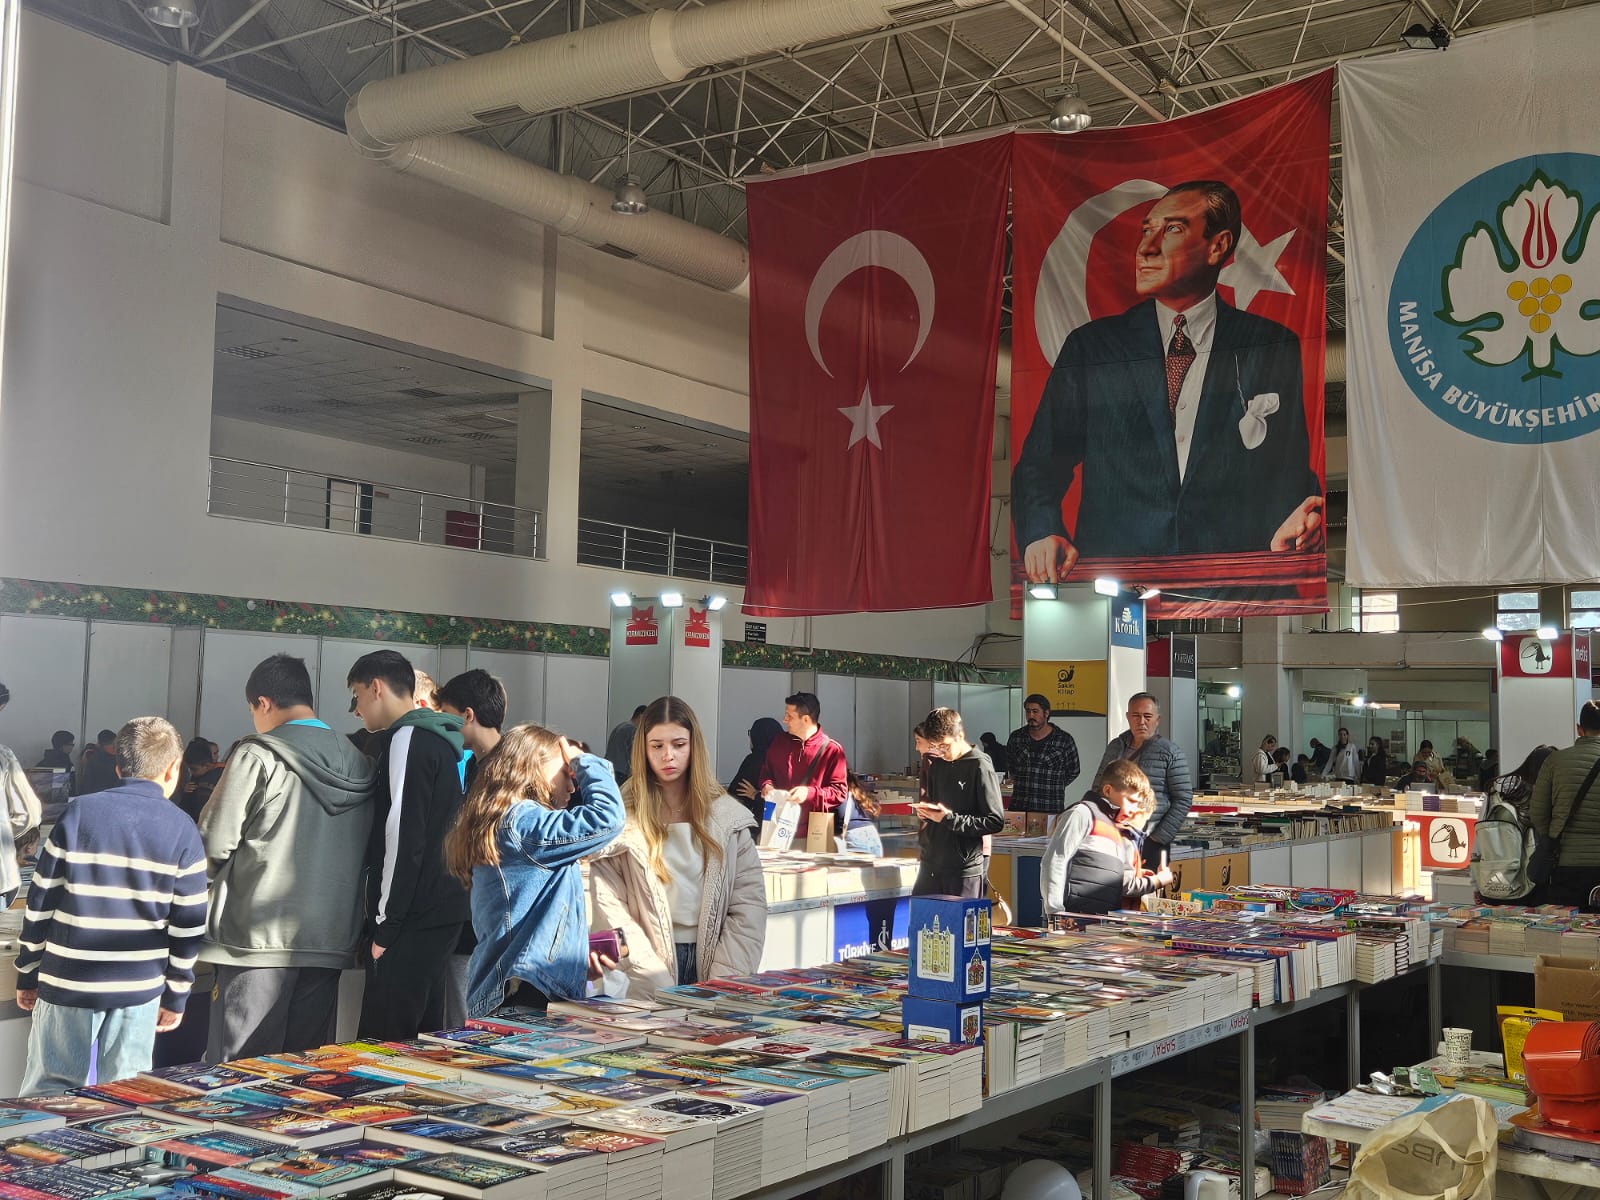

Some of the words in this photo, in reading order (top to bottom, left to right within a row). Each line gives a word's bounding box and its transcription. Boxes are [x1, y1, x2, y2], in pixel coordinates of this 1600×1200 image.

[1399, 300, 1443, 391] MANİSA
[1115, 617, 1140, 636] Kronik
[838, 941, 877, 961] TÜRKİYE
[1151, 1038, 1176, 1058] SARAY
